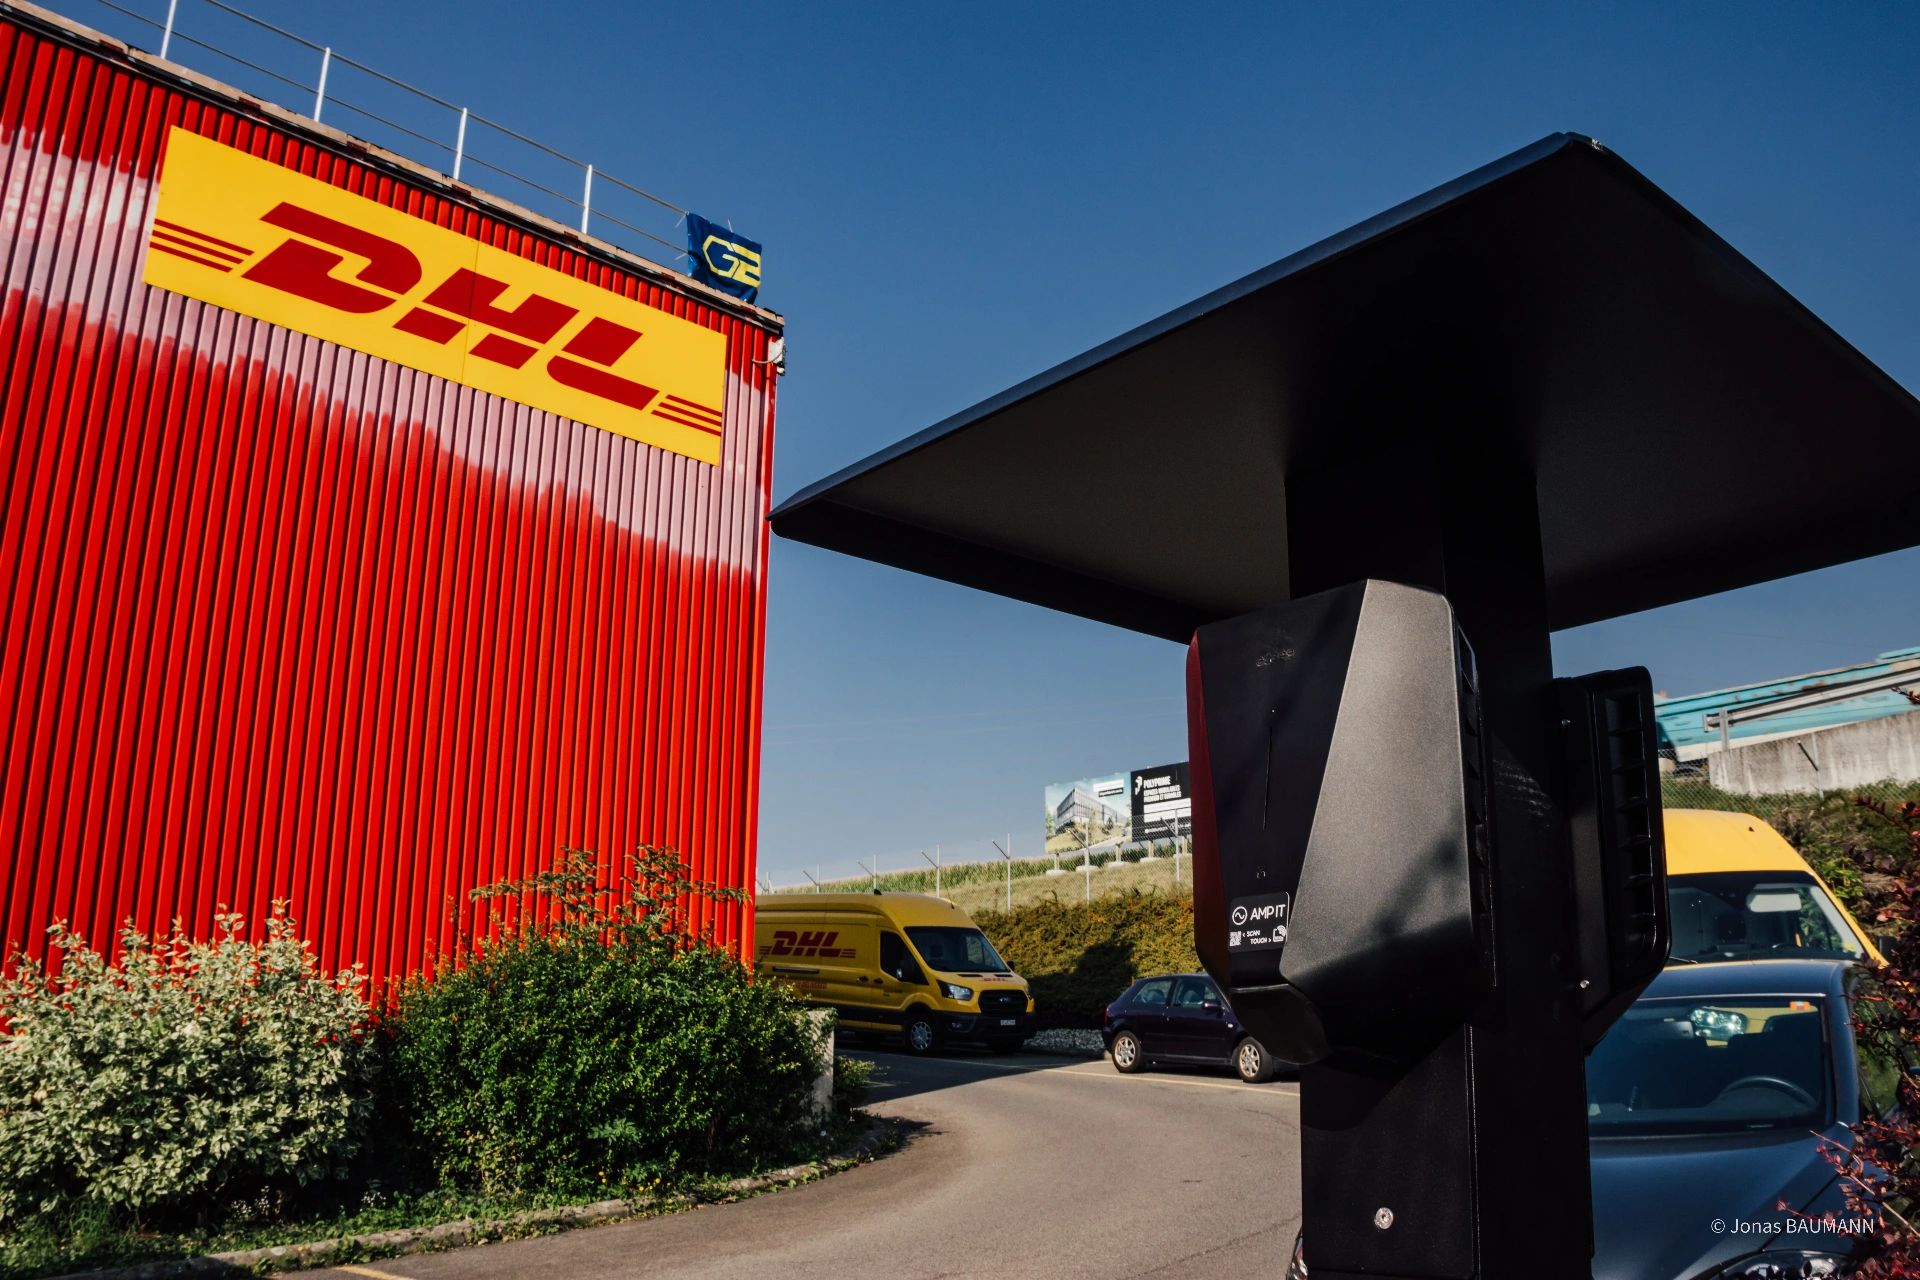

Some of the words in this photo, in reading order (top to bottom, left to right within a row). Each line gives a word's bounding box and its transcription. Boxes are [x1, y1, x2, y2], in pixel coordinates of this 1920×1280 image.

[241, 201, 661, 411] DHL
[1246, 930, 1260, 938] SCAN
[1250, 937, 1268, 945] TOUCH
[771, 930, 841, 957] DHL
